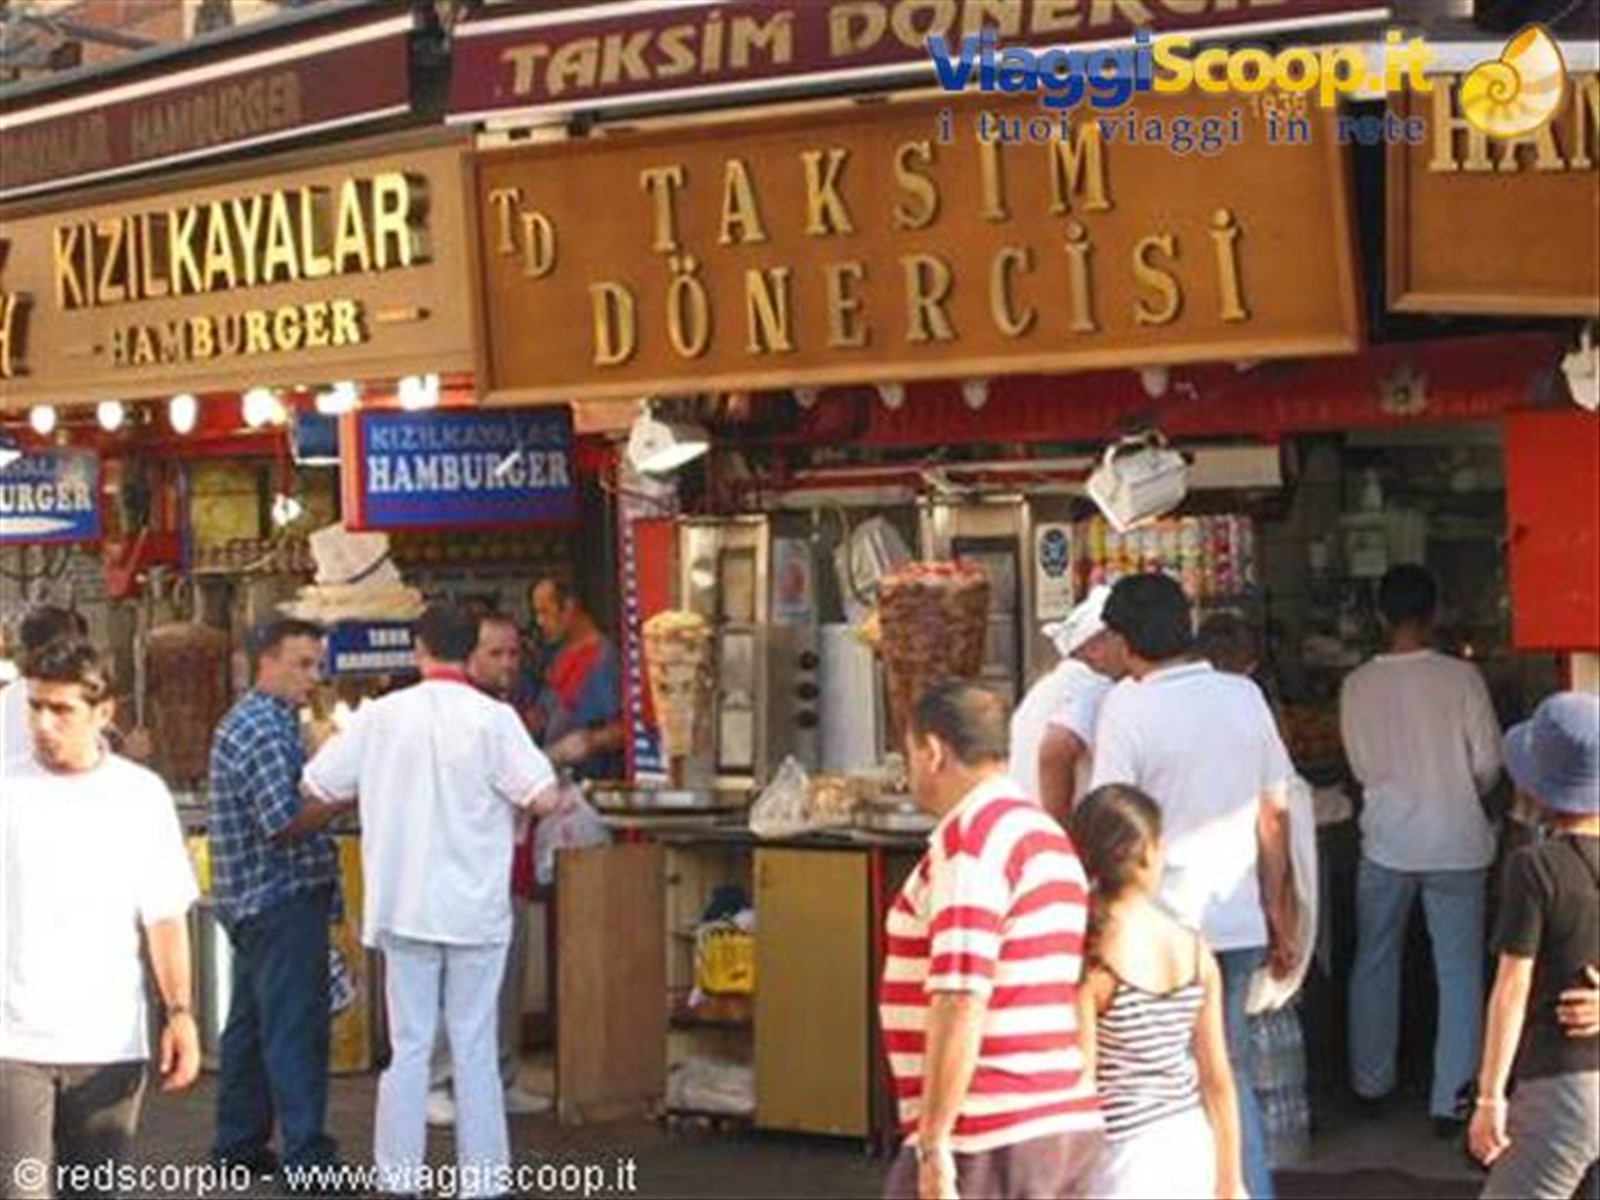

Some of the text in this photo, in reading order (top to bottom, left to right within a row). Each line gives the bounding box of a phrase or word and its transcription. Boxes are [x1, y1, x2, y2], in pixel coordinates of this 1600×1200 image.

[501, 10, 794, 96] TAKSİM
[54, 172, 414, 307] KIZILKAYALAR
[590, 208, 1247, 366] DÖNERCİSİ
[368, 452, 569, 492] HAMBURGER
